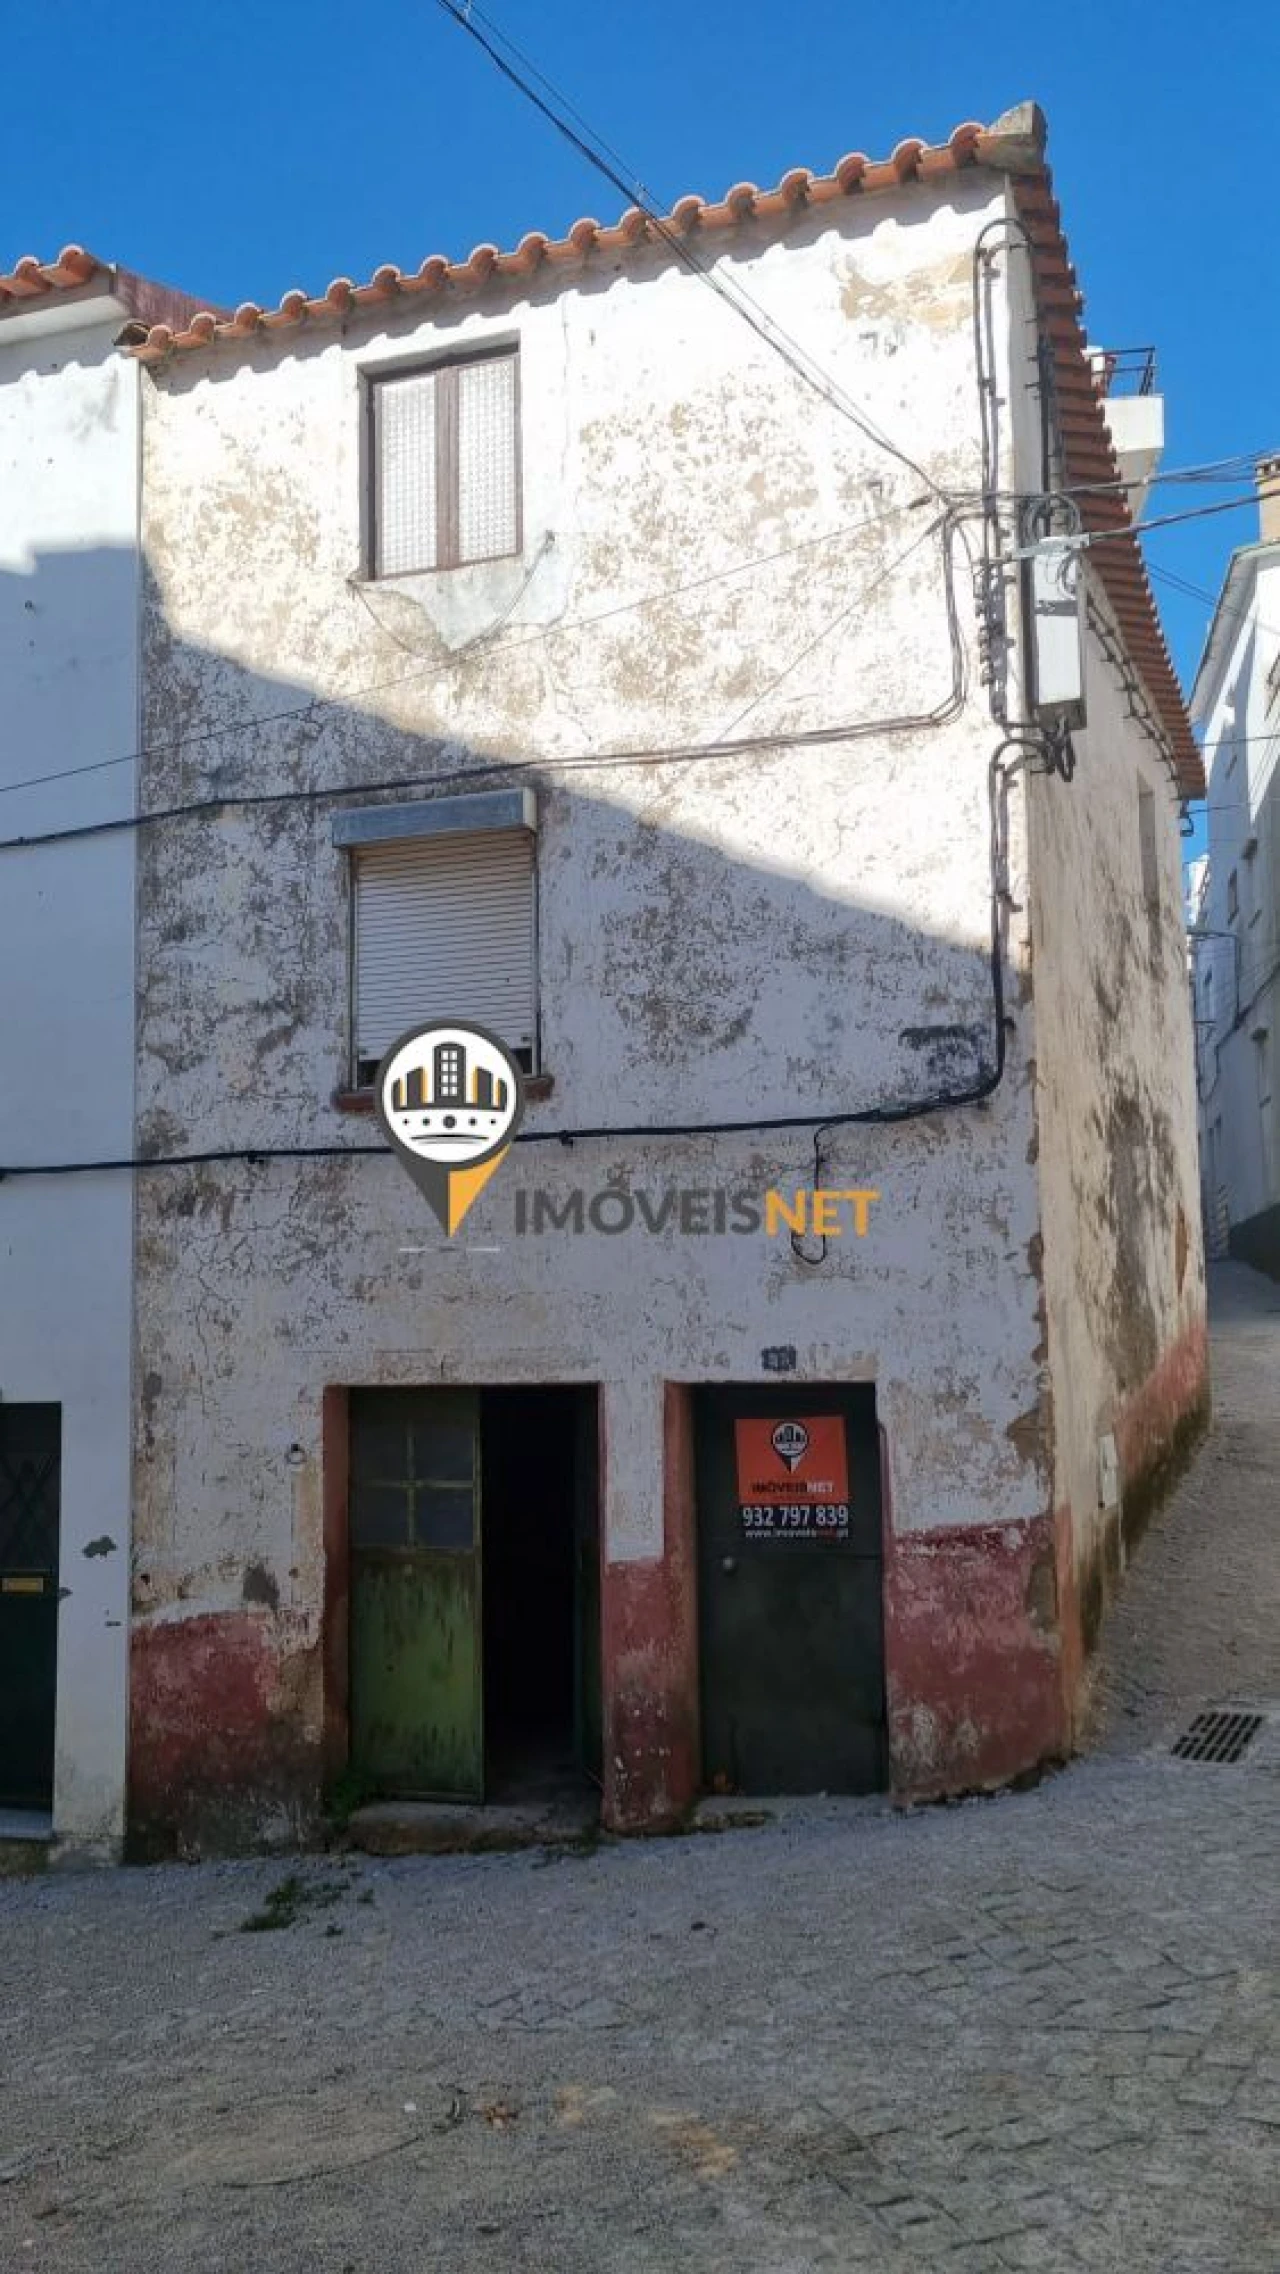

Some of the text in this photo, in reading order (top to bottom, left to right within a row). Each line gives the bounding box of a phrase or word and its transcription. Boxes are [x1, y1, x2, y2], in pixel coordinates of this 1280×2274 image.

[743, 1504, 848, 1526] 932 797 839
